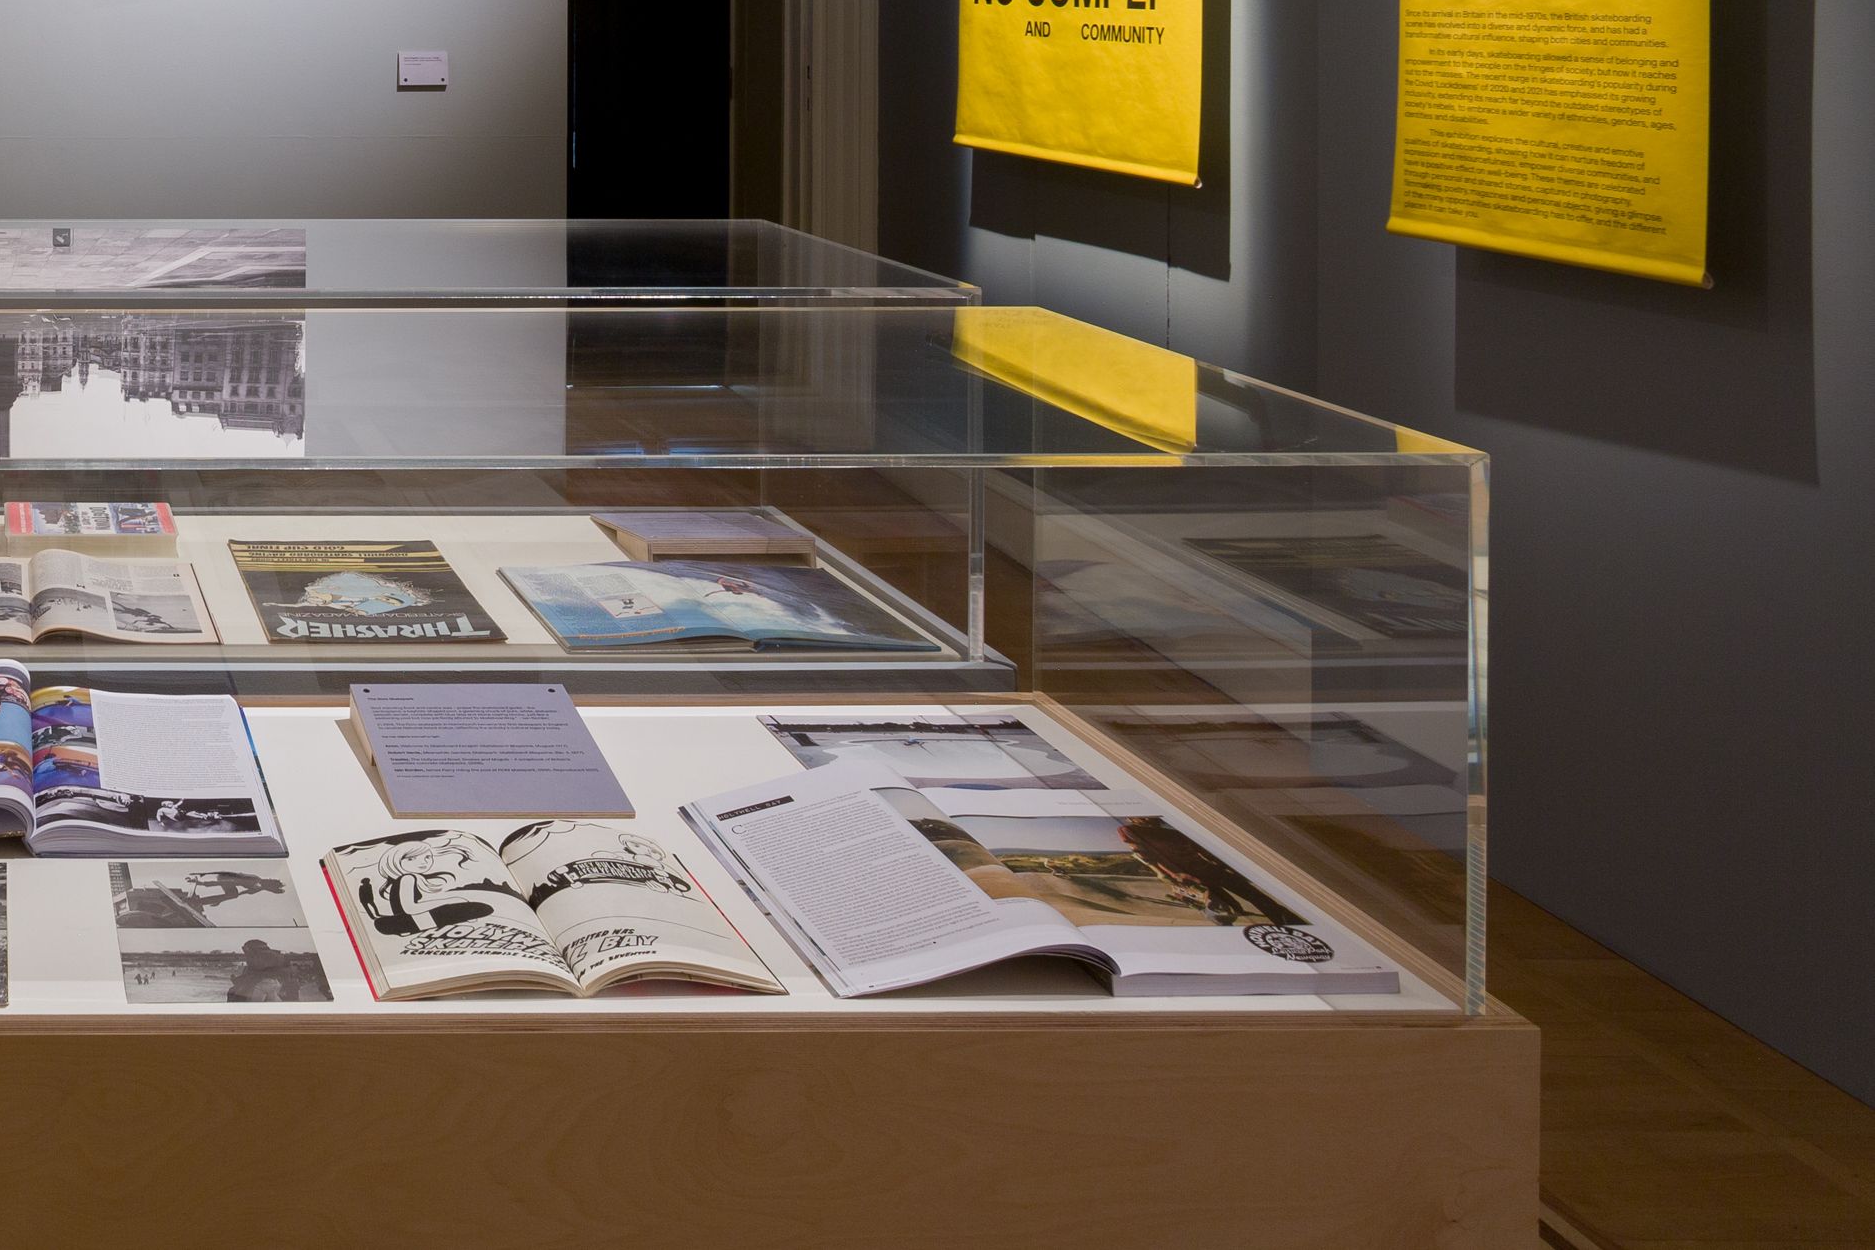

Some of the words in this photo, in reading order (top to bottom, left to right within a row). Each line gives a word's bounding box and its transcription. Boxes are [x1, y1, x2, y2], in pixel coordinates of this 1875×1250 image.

[1564, 13, 1589, 21] British
[1590, 14, 1652, 24] skateboarding
[1025, 20, 1051, 38] AND
[1080, 23, 1165, 45] COMMUNITY
[1614, 57, 1657, 68] belonging
[1658, 59, 1679, 68] and
[1637, 72, 1676, 80] reaches
[1645, 85, 1677, 94] during
[276, 614, 491, 639] THRASHER
[597, 935, 659, 953] BAY
